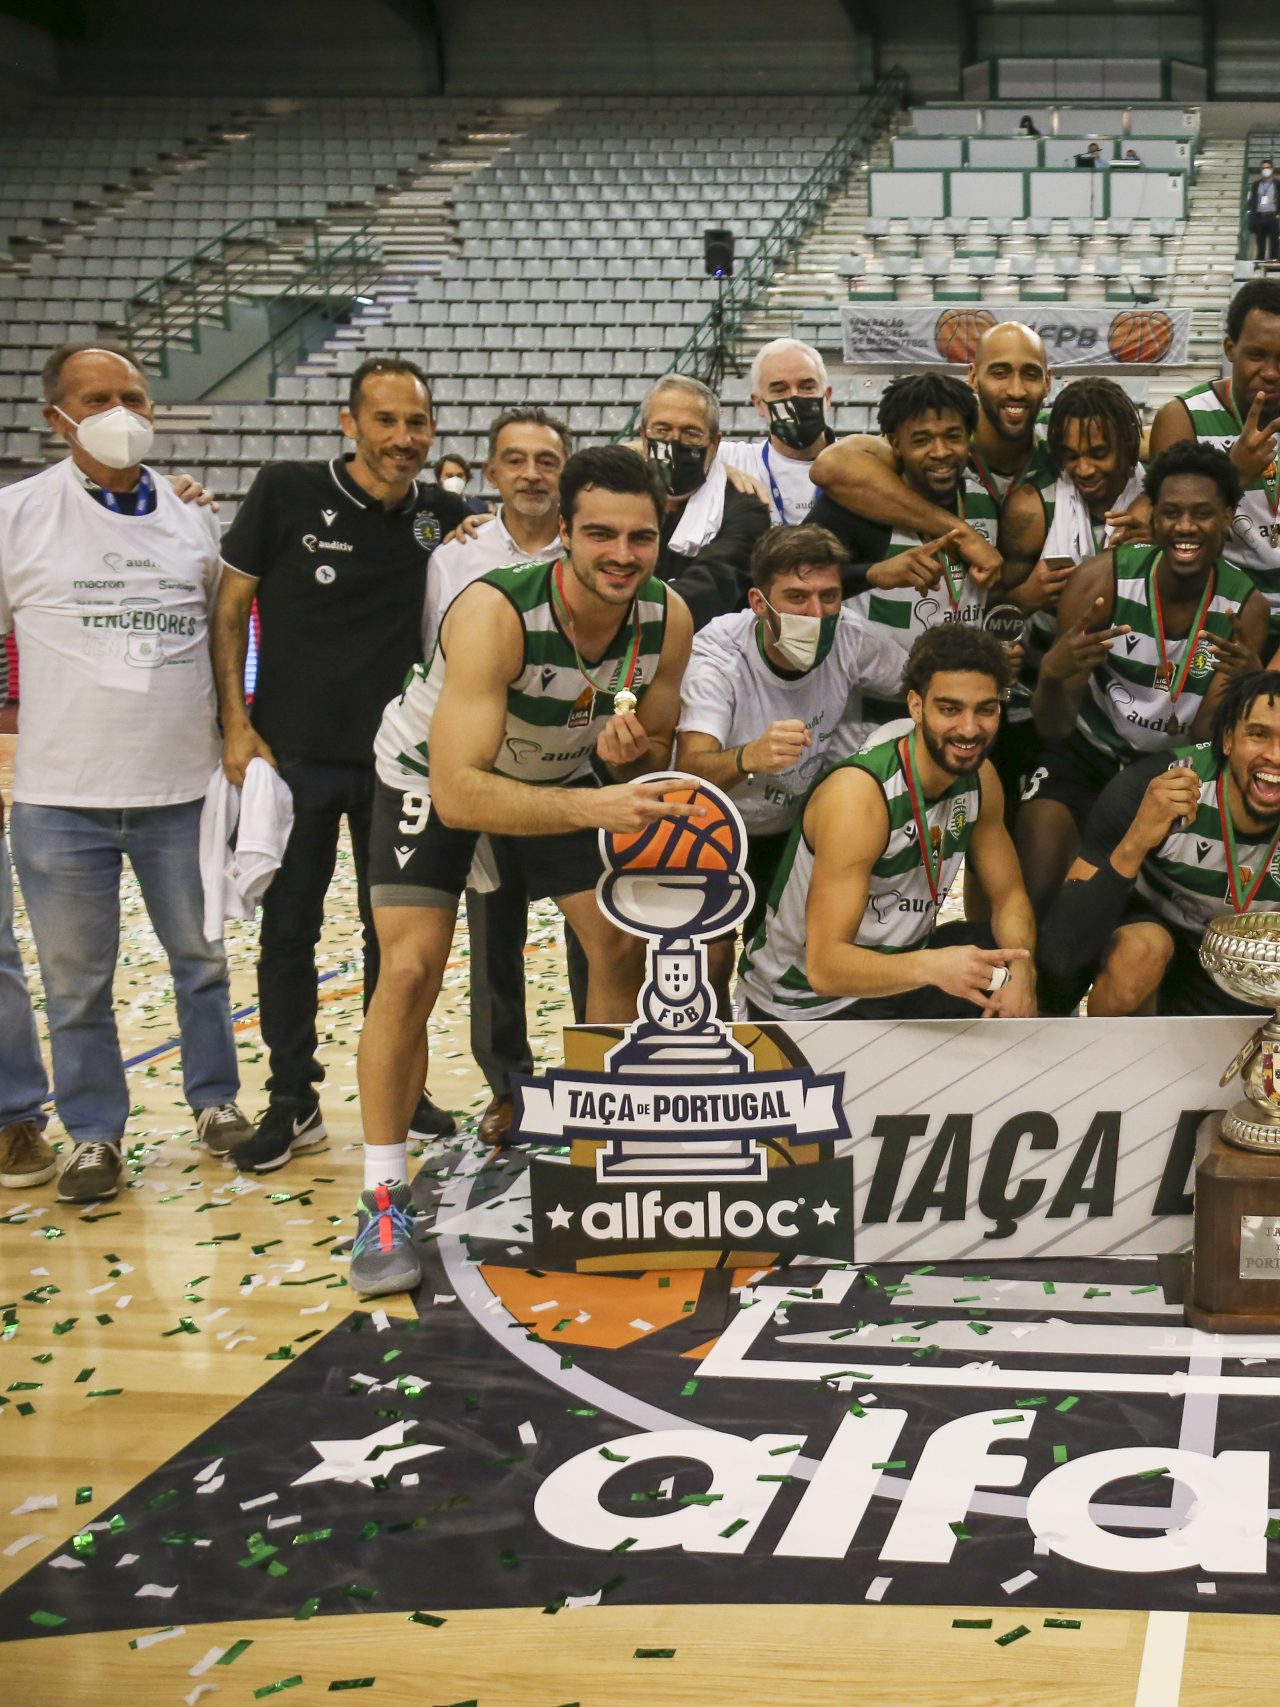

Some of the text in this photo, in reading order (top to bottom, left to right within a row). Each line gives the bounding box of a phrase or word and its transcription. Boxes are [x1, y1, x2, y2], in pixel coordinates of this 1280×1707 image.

[318, 540, 354, 552] auditiv
[73, 579, 126, 590] macron
[82, 609, 197, 637] VENCEDORES
[988, 618, 1024, 631] MVP
[397, 790, 434, 836] 9
[656, 1007, 701, 1028] FPB
[568, 1089, 792, 1126] TAÇA DE PORTUGAL
[861, 1110, 1122, 1240] TAÇA
